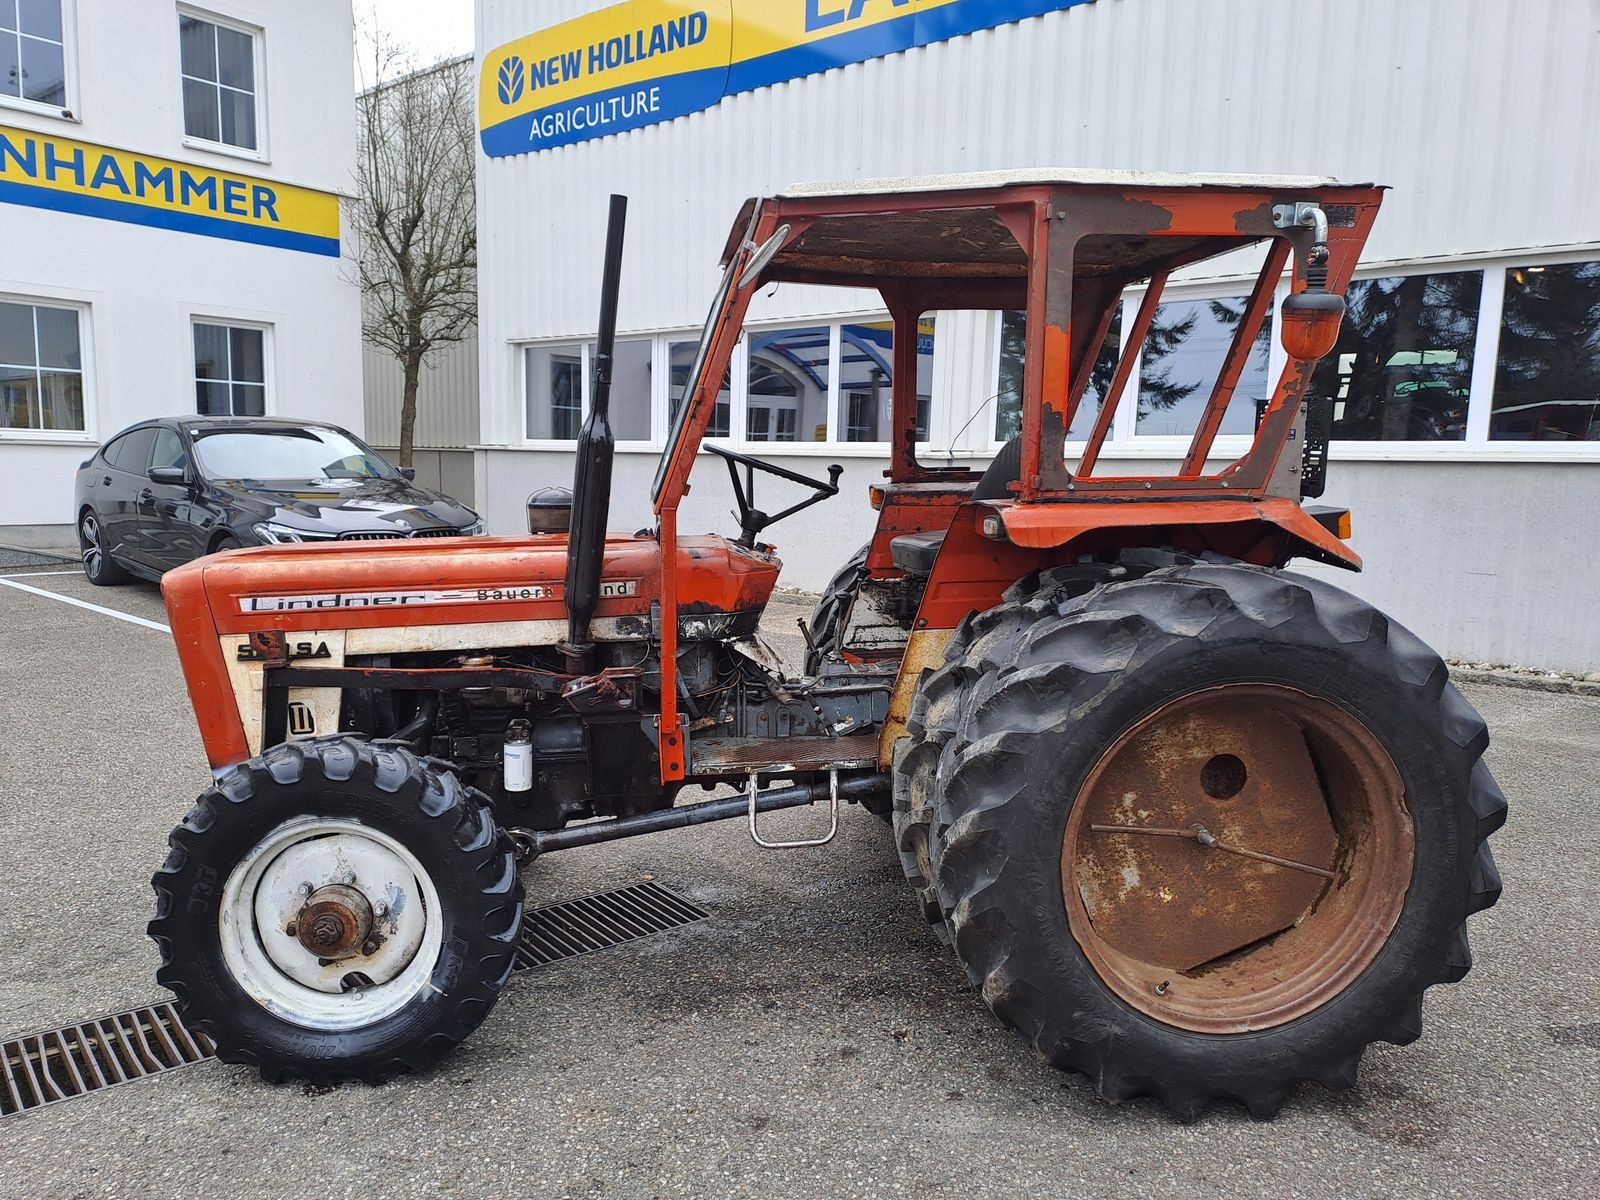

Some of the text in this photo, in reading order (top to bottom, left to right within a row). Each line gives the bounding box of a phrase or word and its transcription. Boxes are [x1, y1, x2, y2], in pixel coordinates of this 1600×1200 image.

[531, 10, 708, 91] NEW HOLLAND
[529, 86, 661, 141] AGRICULTURE
[0, 132, 280, 223] NHAMMER
[251, 593, 425, 612] Lindner
